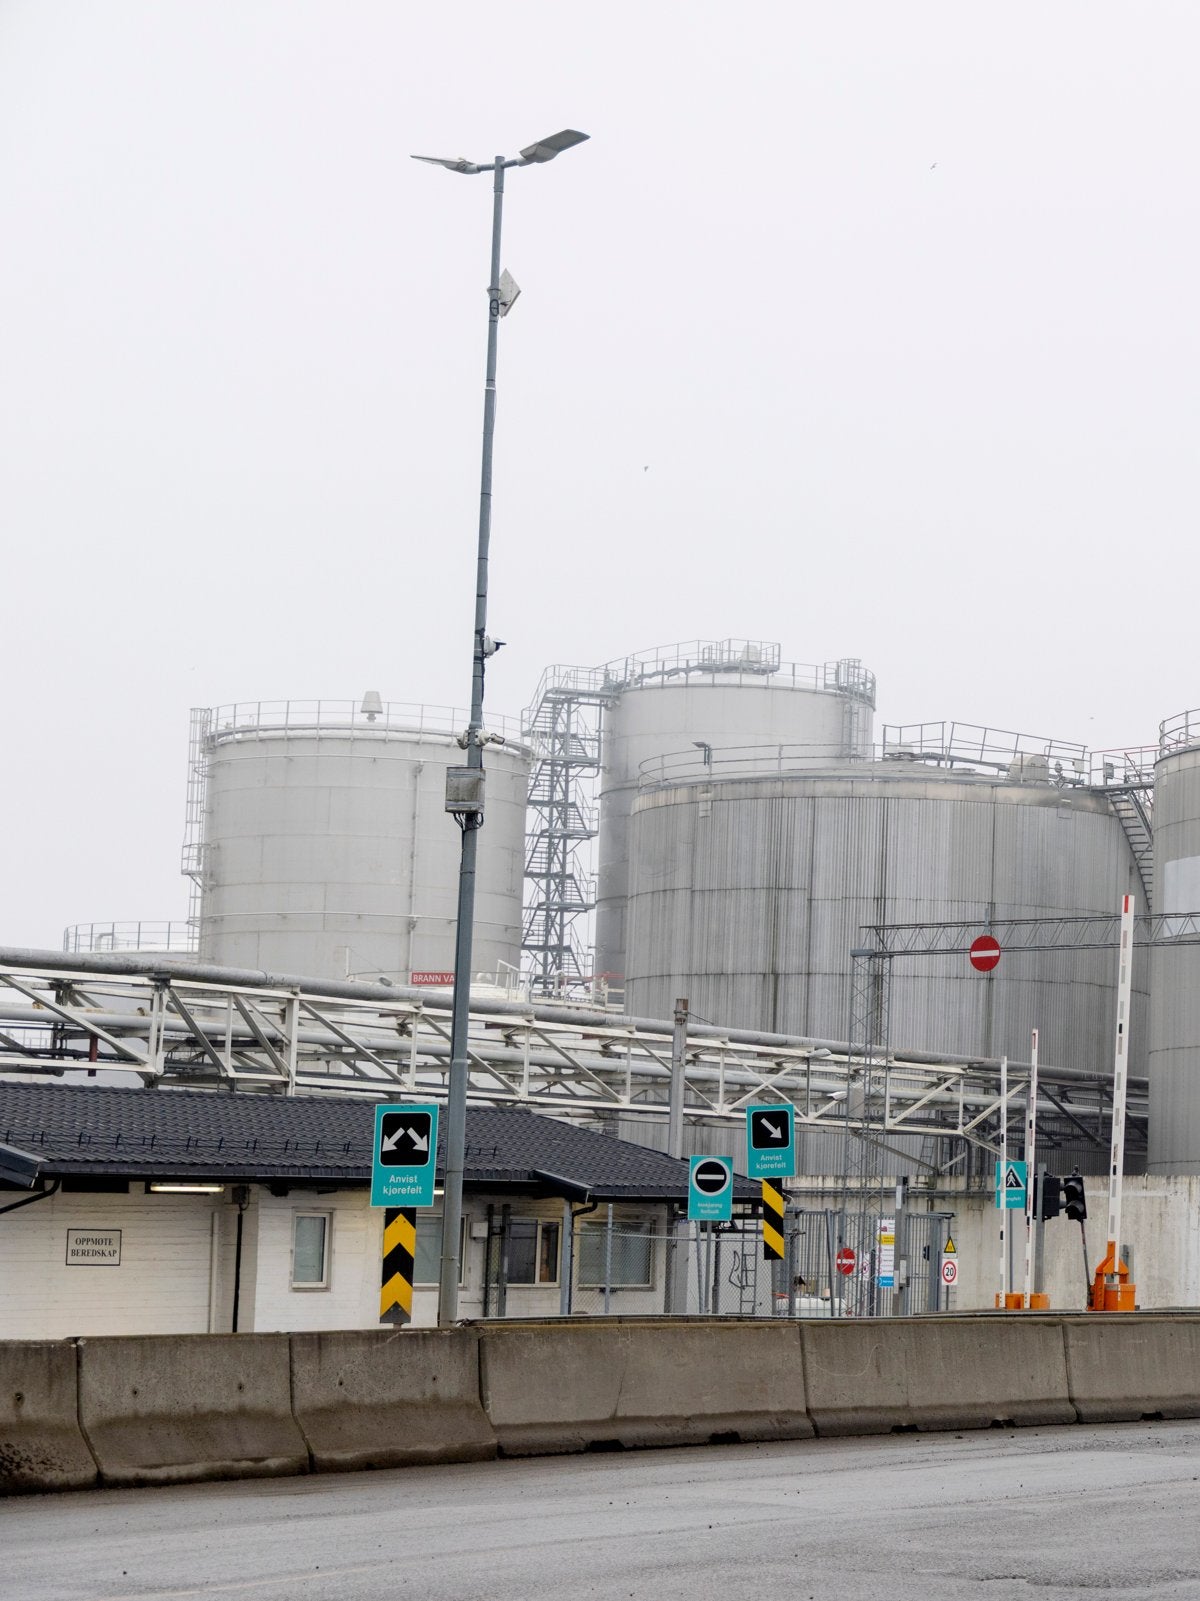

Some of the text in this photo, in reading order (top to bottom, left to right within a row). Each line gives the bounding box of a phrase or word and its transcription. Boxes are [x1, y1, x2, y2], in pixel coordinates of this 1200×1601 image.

[413, 974, 456, 983] BRANN VA
[760, 1154, 783, 1162] Anvist
[755, 1162, 787, 1170] kjørefelt
[389, 1174, 418, 1184] Anvist
[382, 1185, 423, 1197] kjørefelt
[70, 1248, 118, 1257] BEREDSKAP
[945, 1266, 955, 1277] 20
